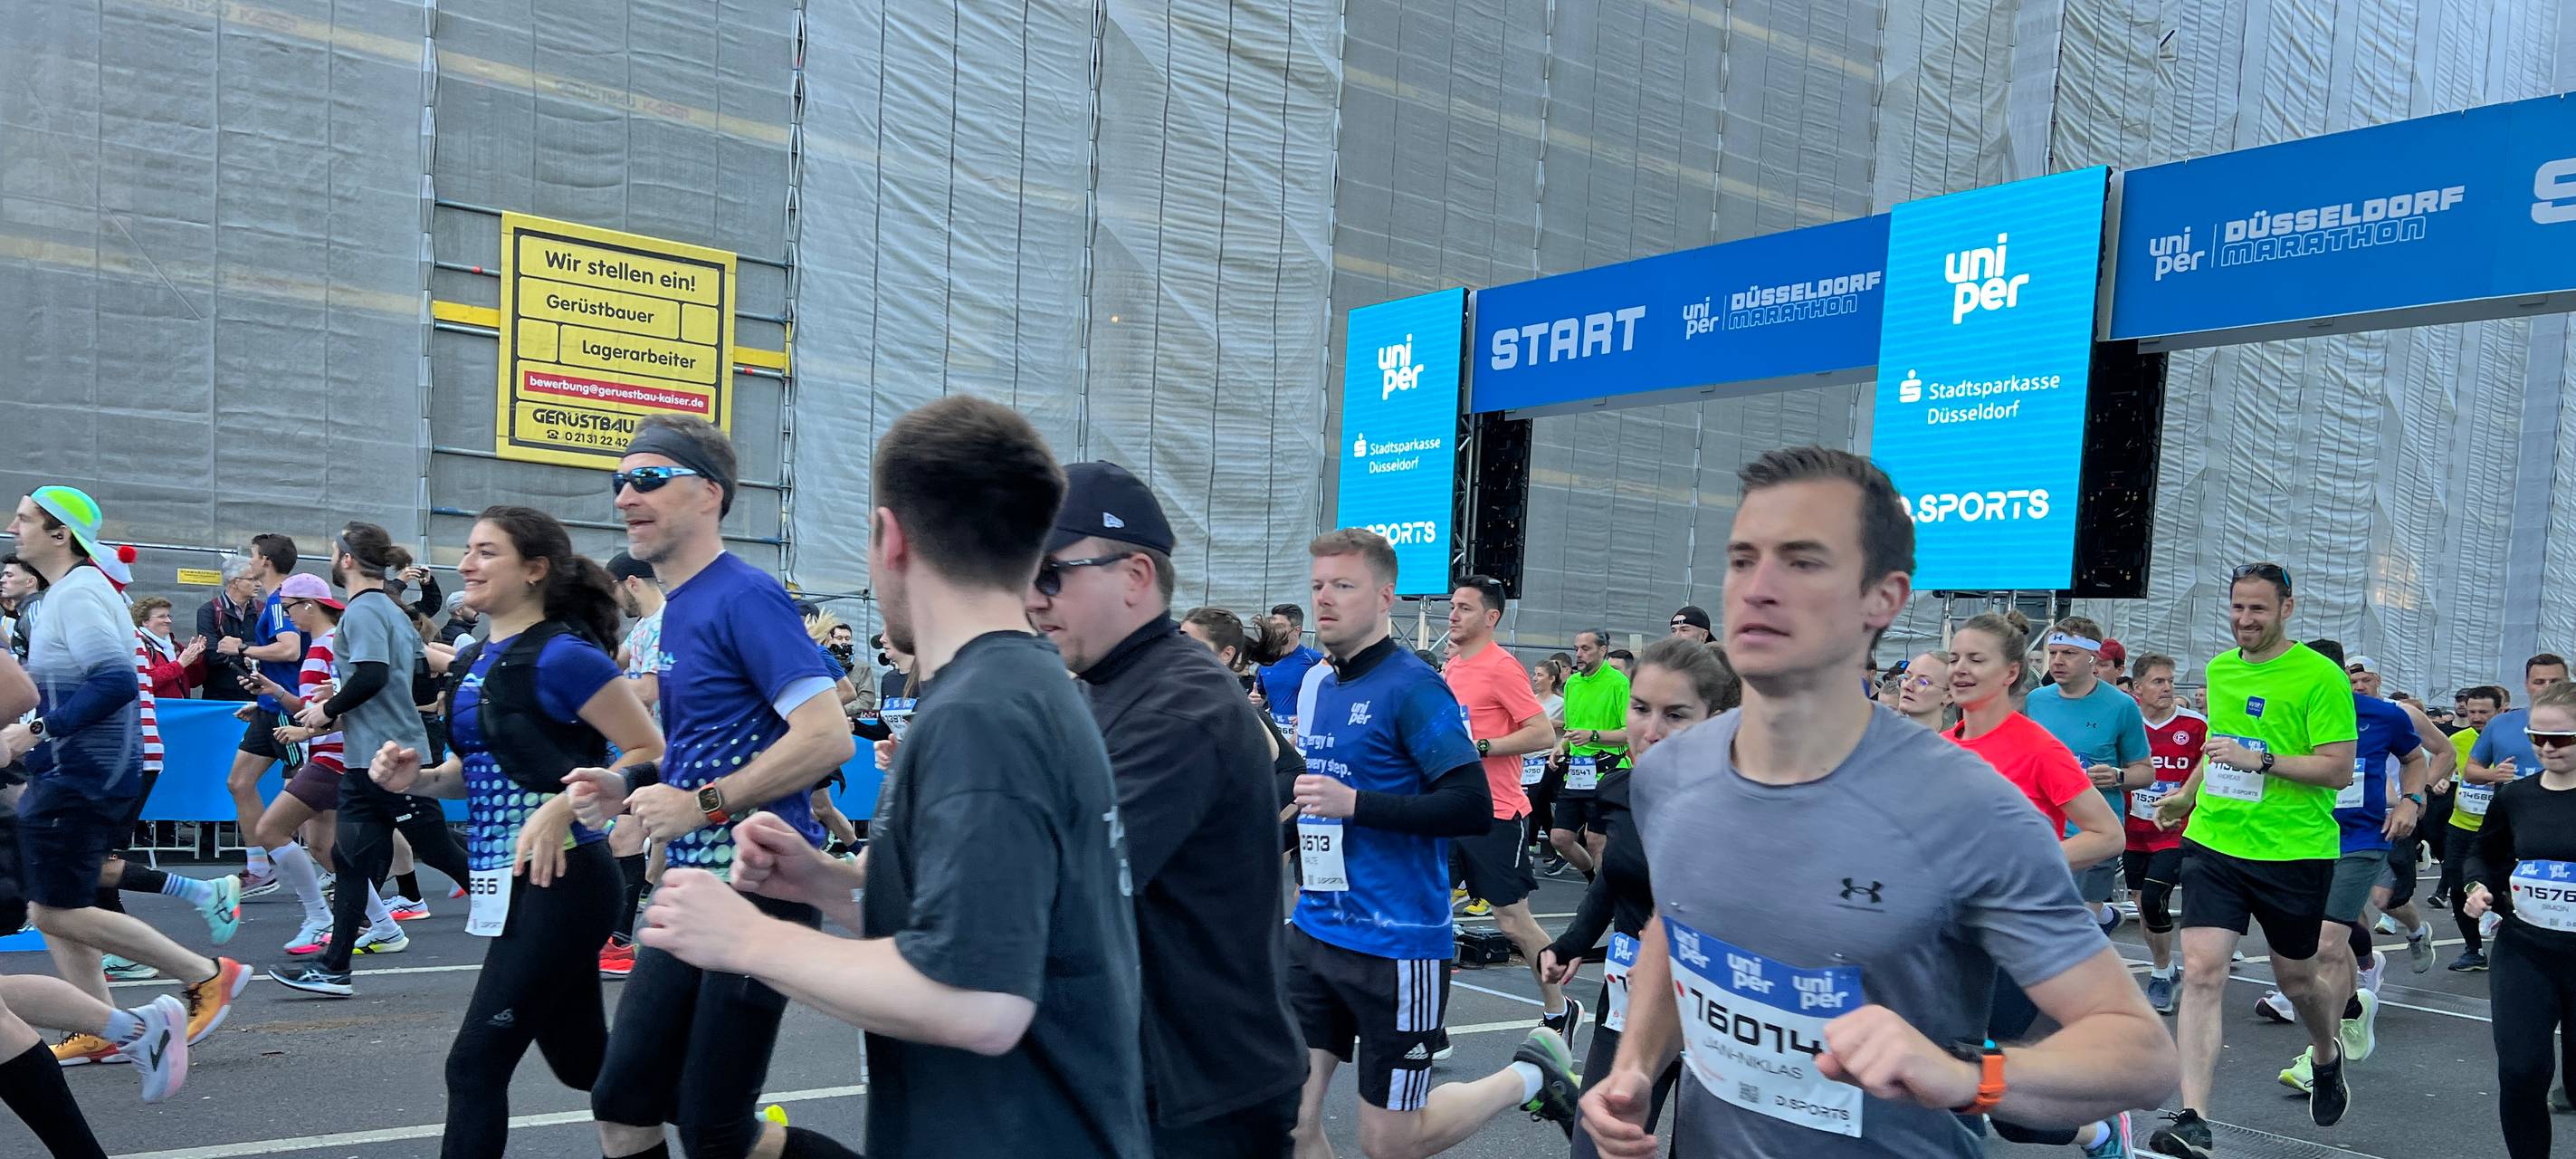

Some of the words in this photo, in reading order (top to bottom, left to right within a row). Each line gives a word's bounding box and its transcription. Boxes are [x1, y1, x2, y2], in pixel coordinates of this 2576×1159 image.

[2224, 185, 2466, 244] DÜSSELDORF
[2150, 226, 2191, 257] uni
[2220, 216, 2427, 267] MARATHON
[545, 250, 581, 272] Wir
[587, 260, 654, 285] stellen
[660, 272, 696, 292] ein!
[1944, 232, 2008, 284] uni
[2154, 250, 2205, 282] per
[1731, 271, 1882, 311] DÜSSELDORF
[1952, 273, 2030, 325] per
[546, 294, 654, 324] Gerüstbauer
[1683, 296, 1711, 321] uni
[1728, 293, 1858, 330] MARATHON
[1491, 305, 1646, 371] START
[1685, 316, 1719, 340] per
[582, 340, 696, 369] Lagerarbeiter
[1378, 333, 1413, 370] uni
[530, 376, 704, 408] bewerbung@geruestbau-kaiser.de
[1381, 364, 1425, 400] per
[1929, 374, 2061, 401] Stadtsparkasse
[1927, 399, 2021, 425] Düsseldorf
[1369, 436, 1441, 456] Stadtsparkasse
[1369, 456, 1420, 474] Düsseldorf
[1328, 759, 1351, 778] step.
[1727, 953, 1761, 978] uni
[1732, 971, 1775, 994] per
[1792, 972, 1833, 993] uni
[1800, 991, 1848, 1010] per
[1690, 987, 1824, 1058] 16014
[1774, 1095, 1850, 1121] D.SPORTS
